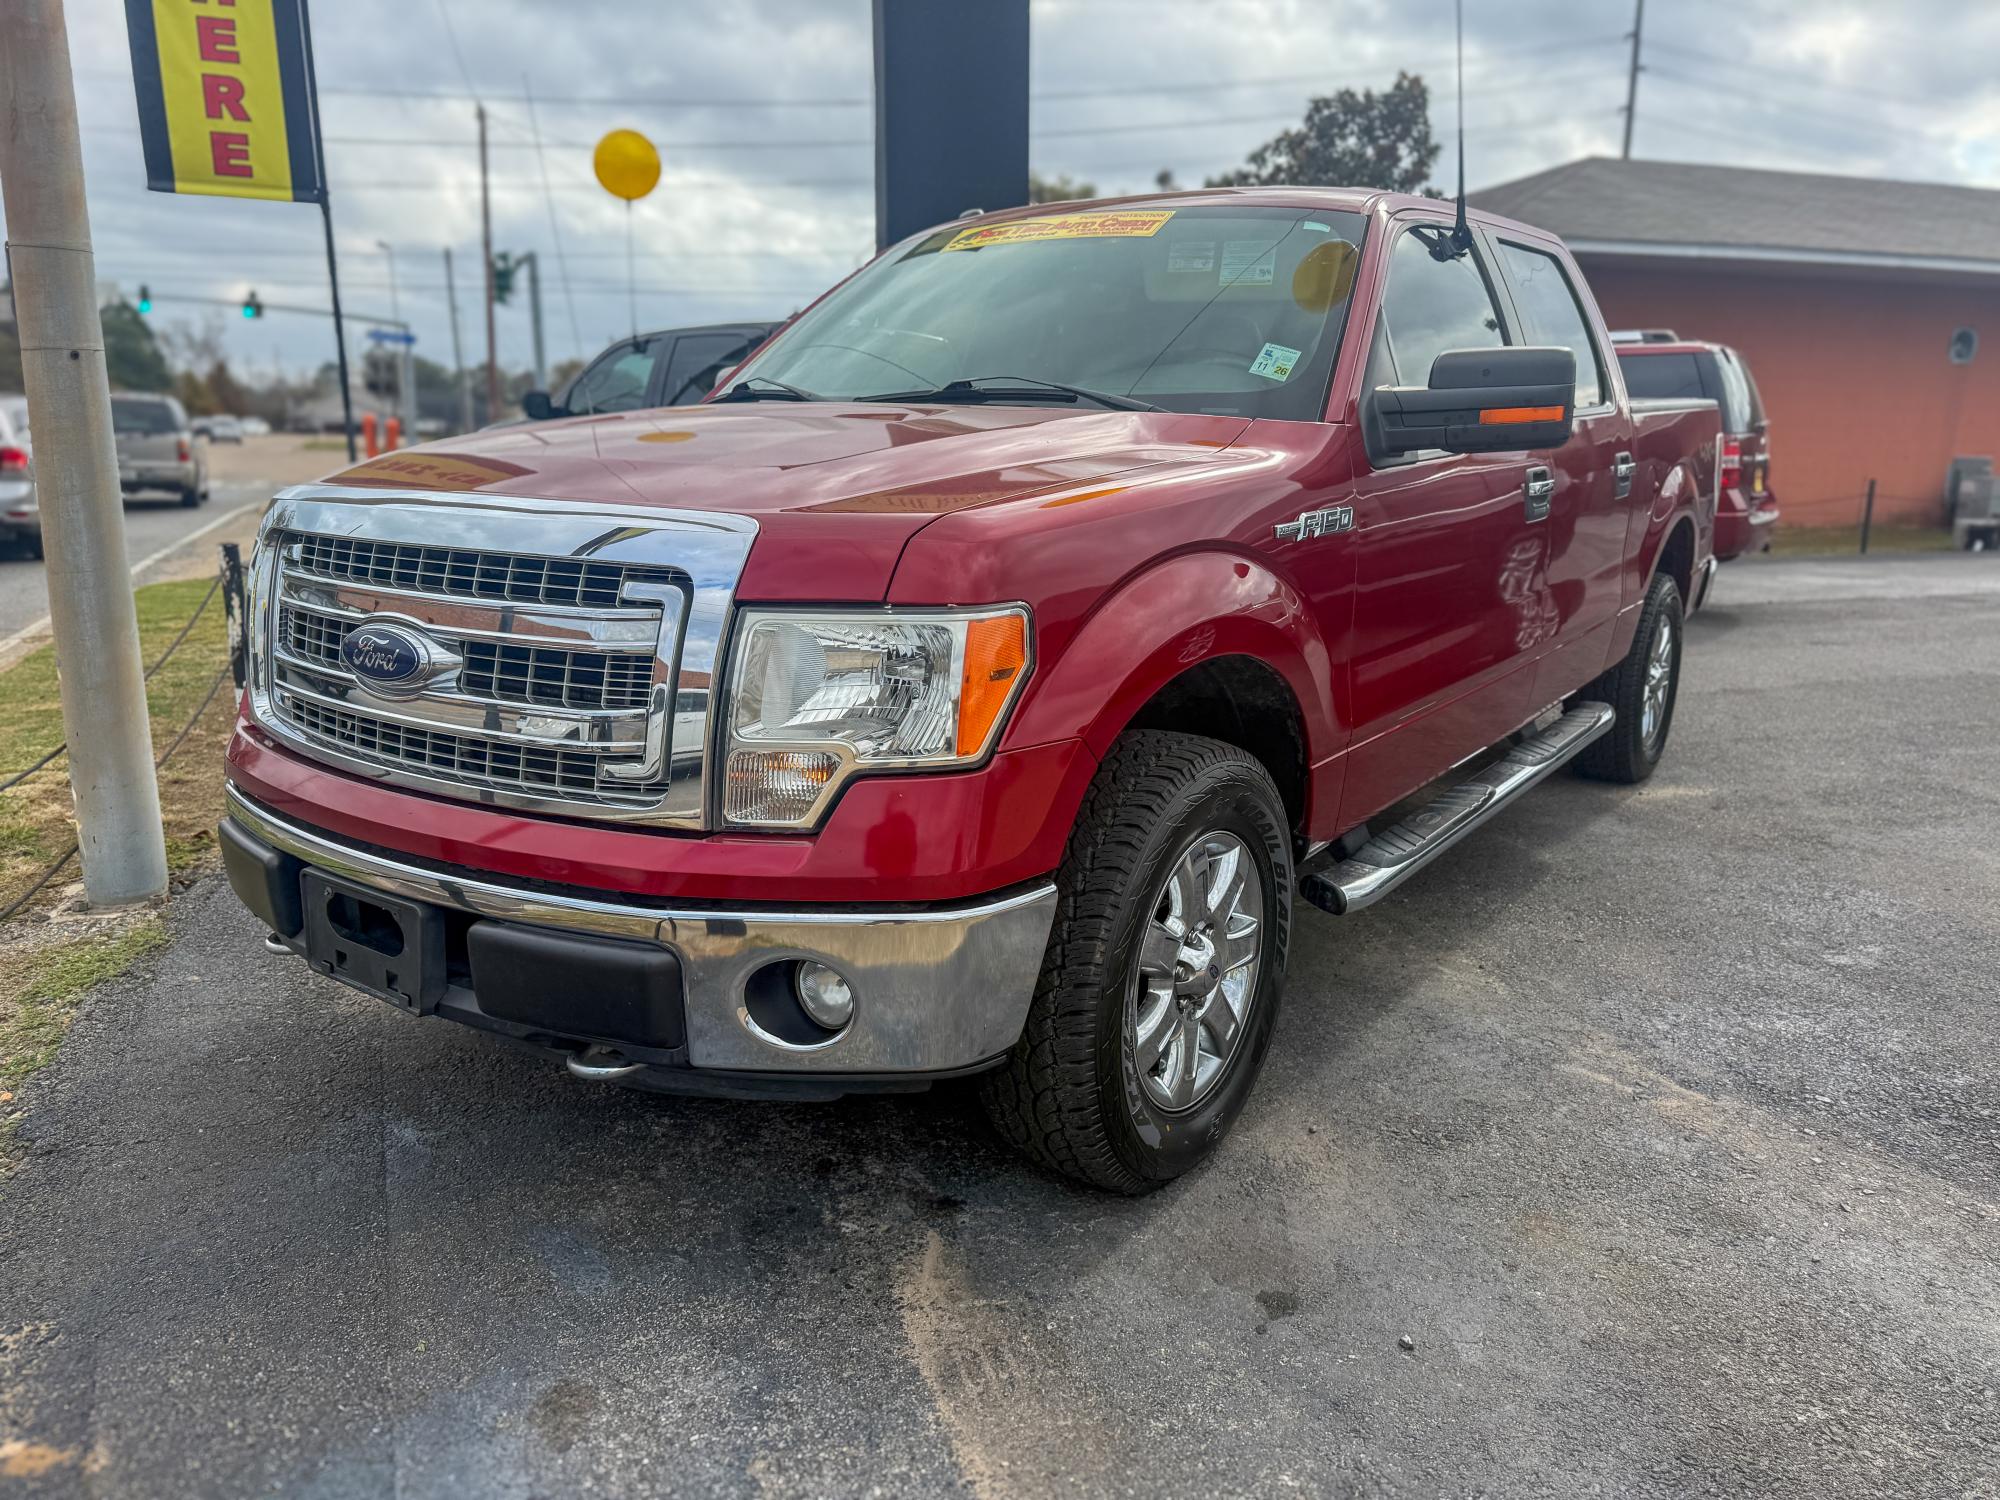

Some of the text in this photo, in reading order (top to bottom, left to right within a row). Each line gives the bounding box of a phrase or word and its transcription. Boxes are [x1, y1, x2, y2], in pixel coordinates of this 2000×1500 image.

[189, 0, 254, 178] ERE
[1257, 361, 1268, 371] 11
[1274, 365, 1288, 376] 26
[352, 634, 400, 671] Ford
[1273, 861, 1290, 974] BLADE
